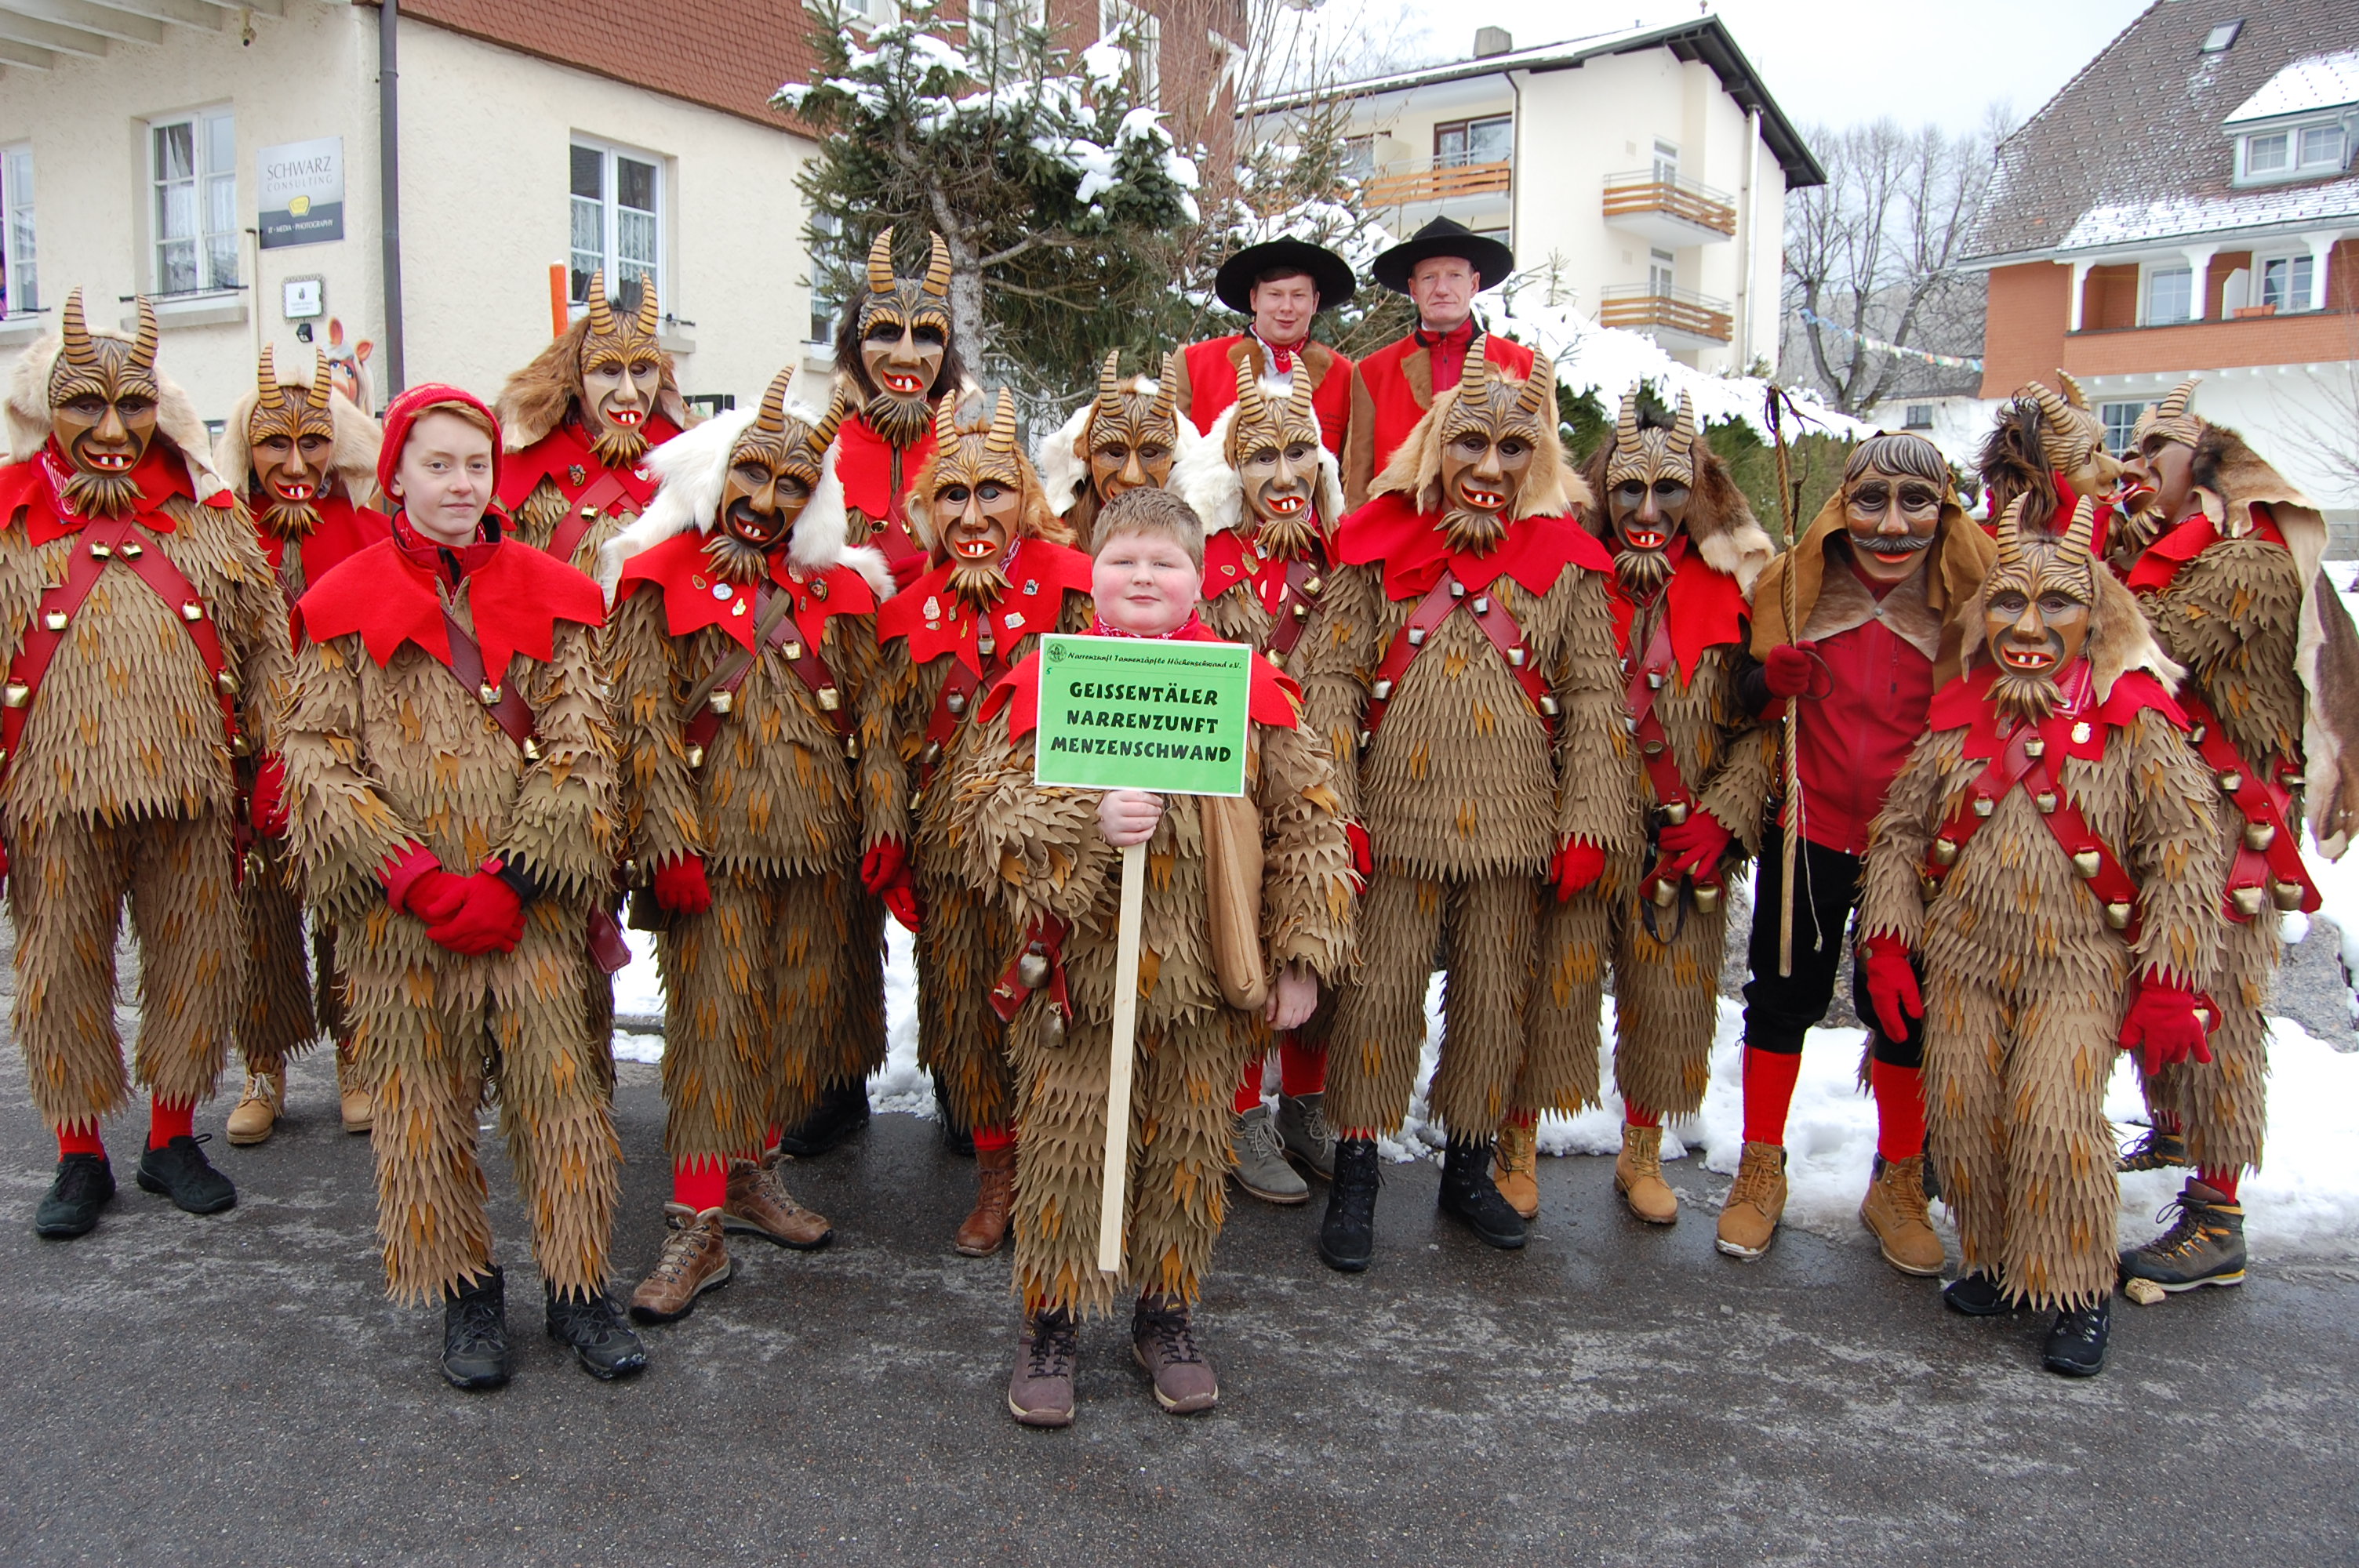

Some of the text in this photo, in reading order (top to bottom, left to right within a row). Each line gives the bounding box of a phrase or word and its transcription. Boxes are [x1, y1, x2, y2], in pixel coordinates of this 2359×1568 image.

[267, 156, 332, 181] SCHWARZ
[267, 174, 333, 193] CONSULTING
[276, 224, 292, 233] MEDIA
[295, 220, 333, 230] PHOTOGRAPHY
[1067, 652, 1112, 662] Narrenzunft
[1069, 681, 1219, 706] GEISSENTÄLER
[1067, 710, 1219, 734] NARRENZUNFT
[1050, 736, 1231, 762] MENZENSCHWAND
